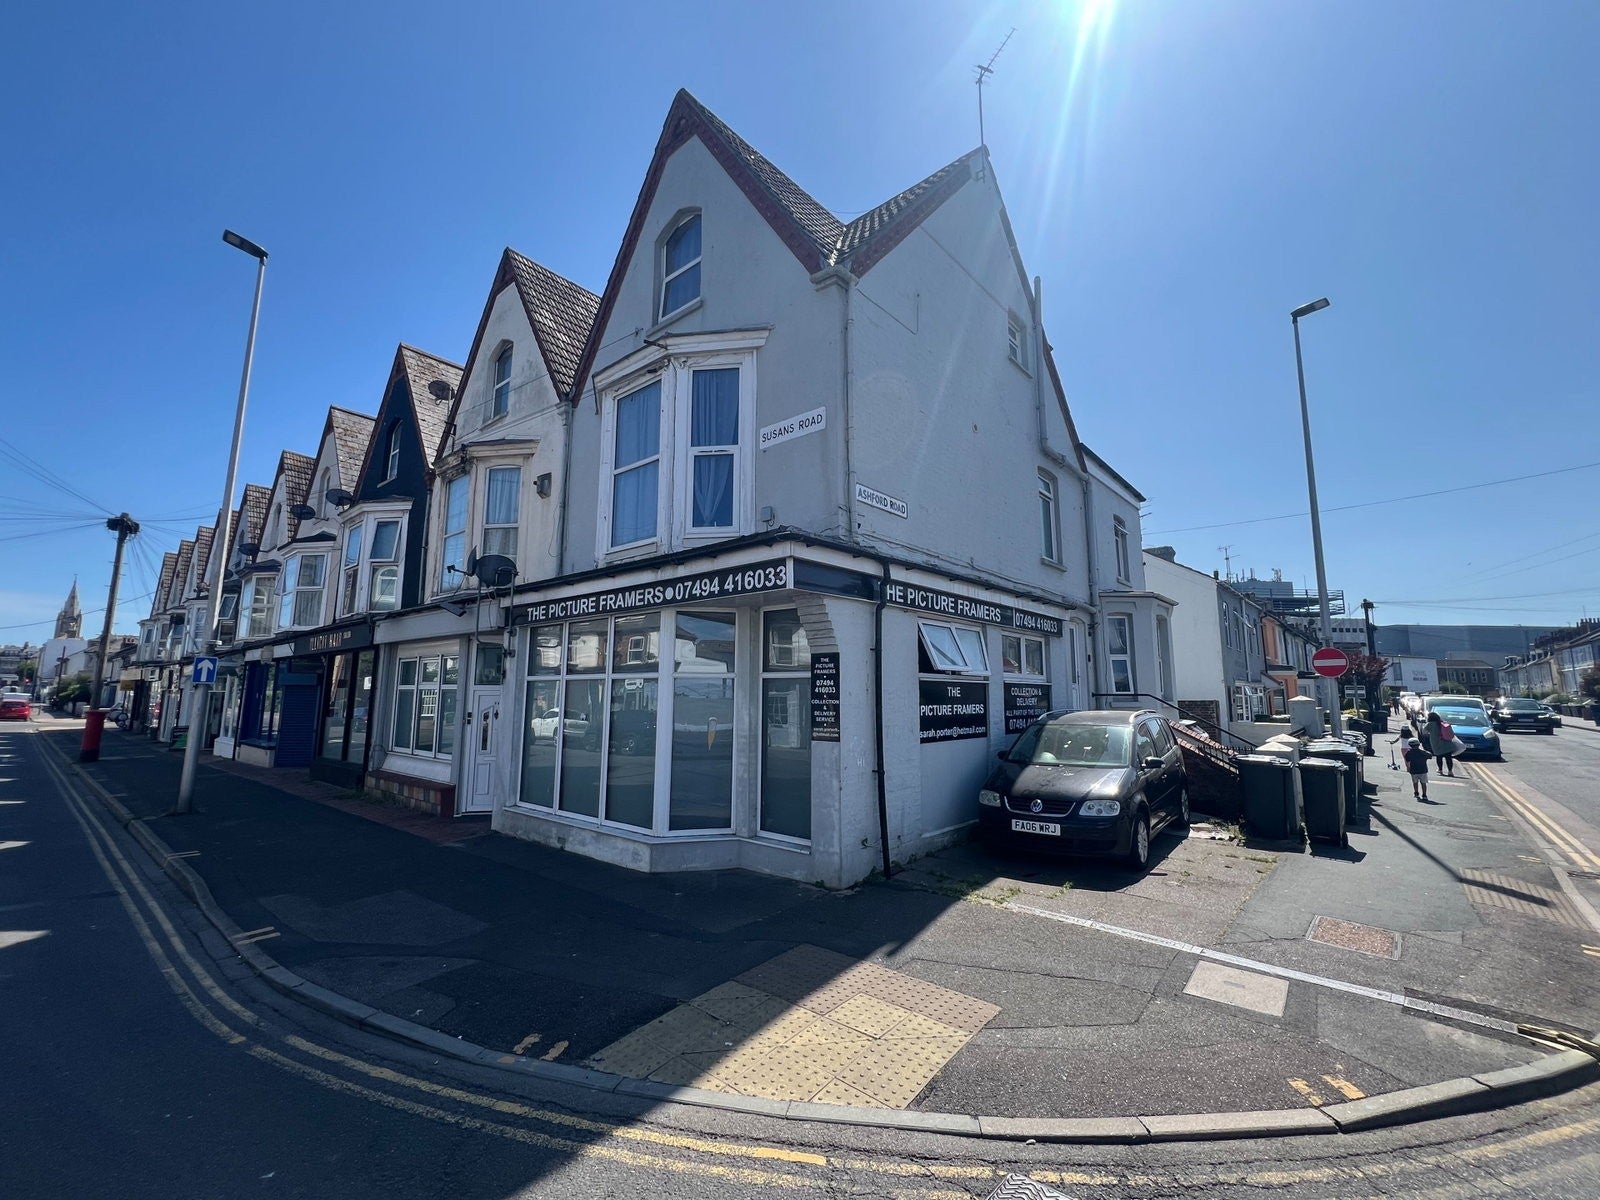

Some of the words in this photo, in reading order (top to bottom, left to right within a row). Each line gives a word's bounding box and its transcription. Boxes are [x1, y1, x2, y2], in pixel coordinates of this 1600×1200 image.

[762, 424, 794, 442] SUSANS
[798, 414, 822, 430] ROAD
[858, 488, 888, 508] ASHFORD
[890, 500, 906, 514] ROAD
[527, 607, 546, 622] THE
[548, 597, 596, 618] PICTURE
[600, 586, 664, 611] FRAMERS
[675, 577, 720, 601] 07494
[724, 565, 786, 593] 416033
[886, 584, 904, 602] HE
[908, 588, 955, 613] PICTURE
[958, 600, 1001, 622] FRAMERS
[1016, 612, 1036, 628] 07494
[1036, 618, 1058, 632] 416033
[947, 686, 961, 697] THE
[1010, 688, 1038, 696] COLLECTION
[920, 704, 952, 716] PICTURE
[953, 704, 984, 714] FRAMERS
[1016, 697, 1038, 706] DELIVERY
[1014, 820, 1037, 832] FA06
[1038, 823, 1057, 834] WRJ
